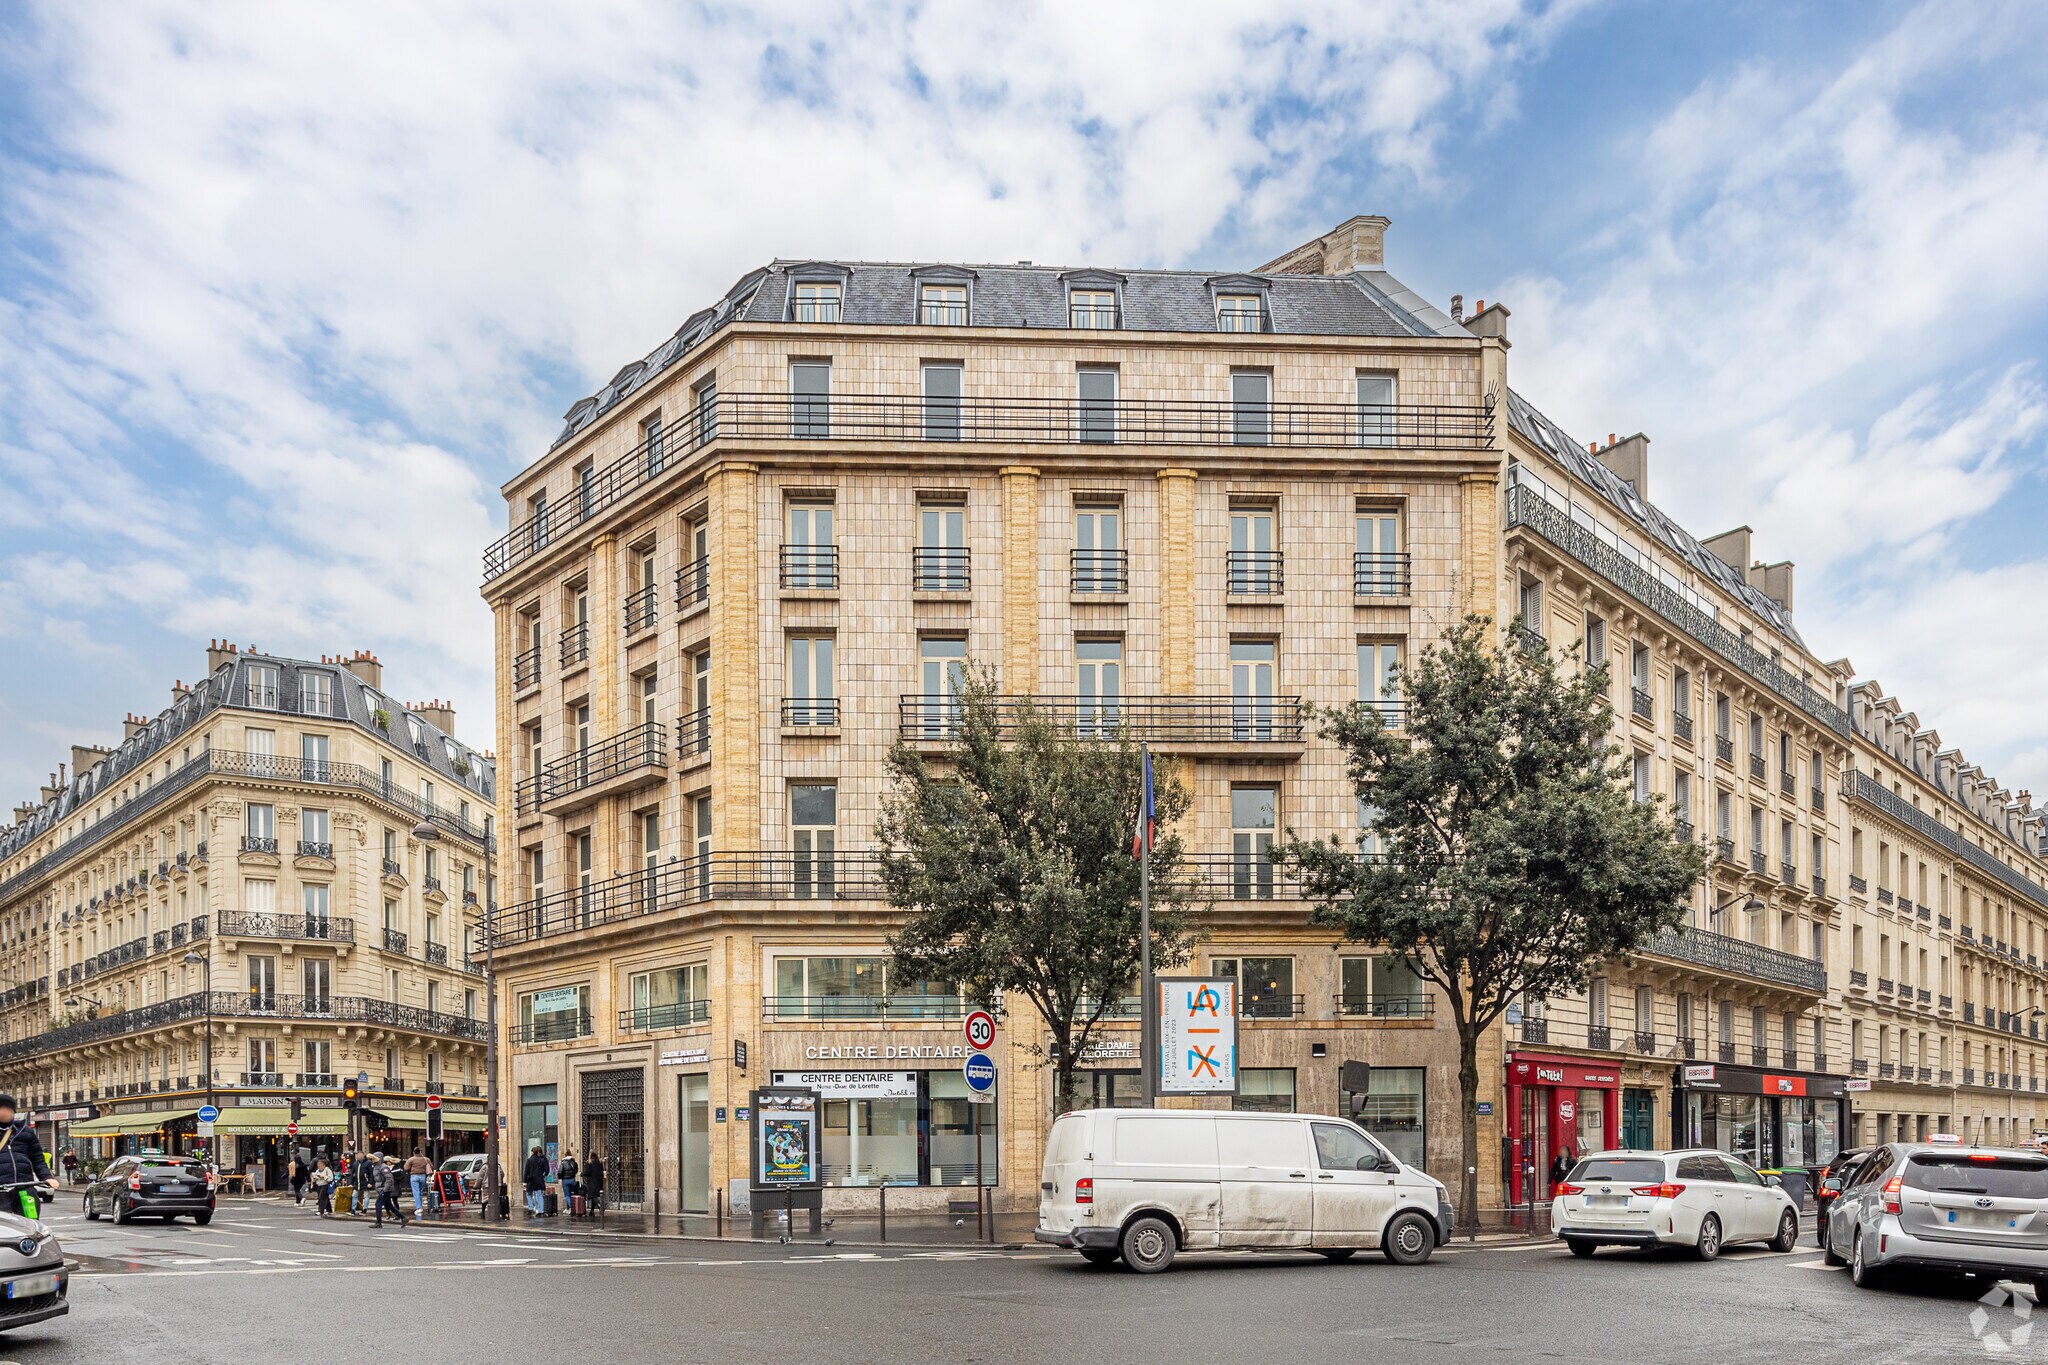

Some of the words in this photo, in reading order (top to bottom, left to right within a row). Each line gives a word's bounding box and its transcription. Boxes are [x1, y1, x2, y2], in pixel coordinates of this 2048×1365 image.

[972, 1022, 990, 1040] 30
[1107, 1042, 1133, 1050] DAME
[661, 1050, 681, 1058] CENTRE
[805, 1046, 878, 1060] CENTRE
[884, 1045, 974, 1060] DENTAIRE
[1094, 1050, 1133, 1058] ORETTE
[801, 1073, 842, 1083] CENTRE
[844, 1073, 894, 1082] DENTAIRE
[376, 1100, 411, 1108] PATISSERIE
